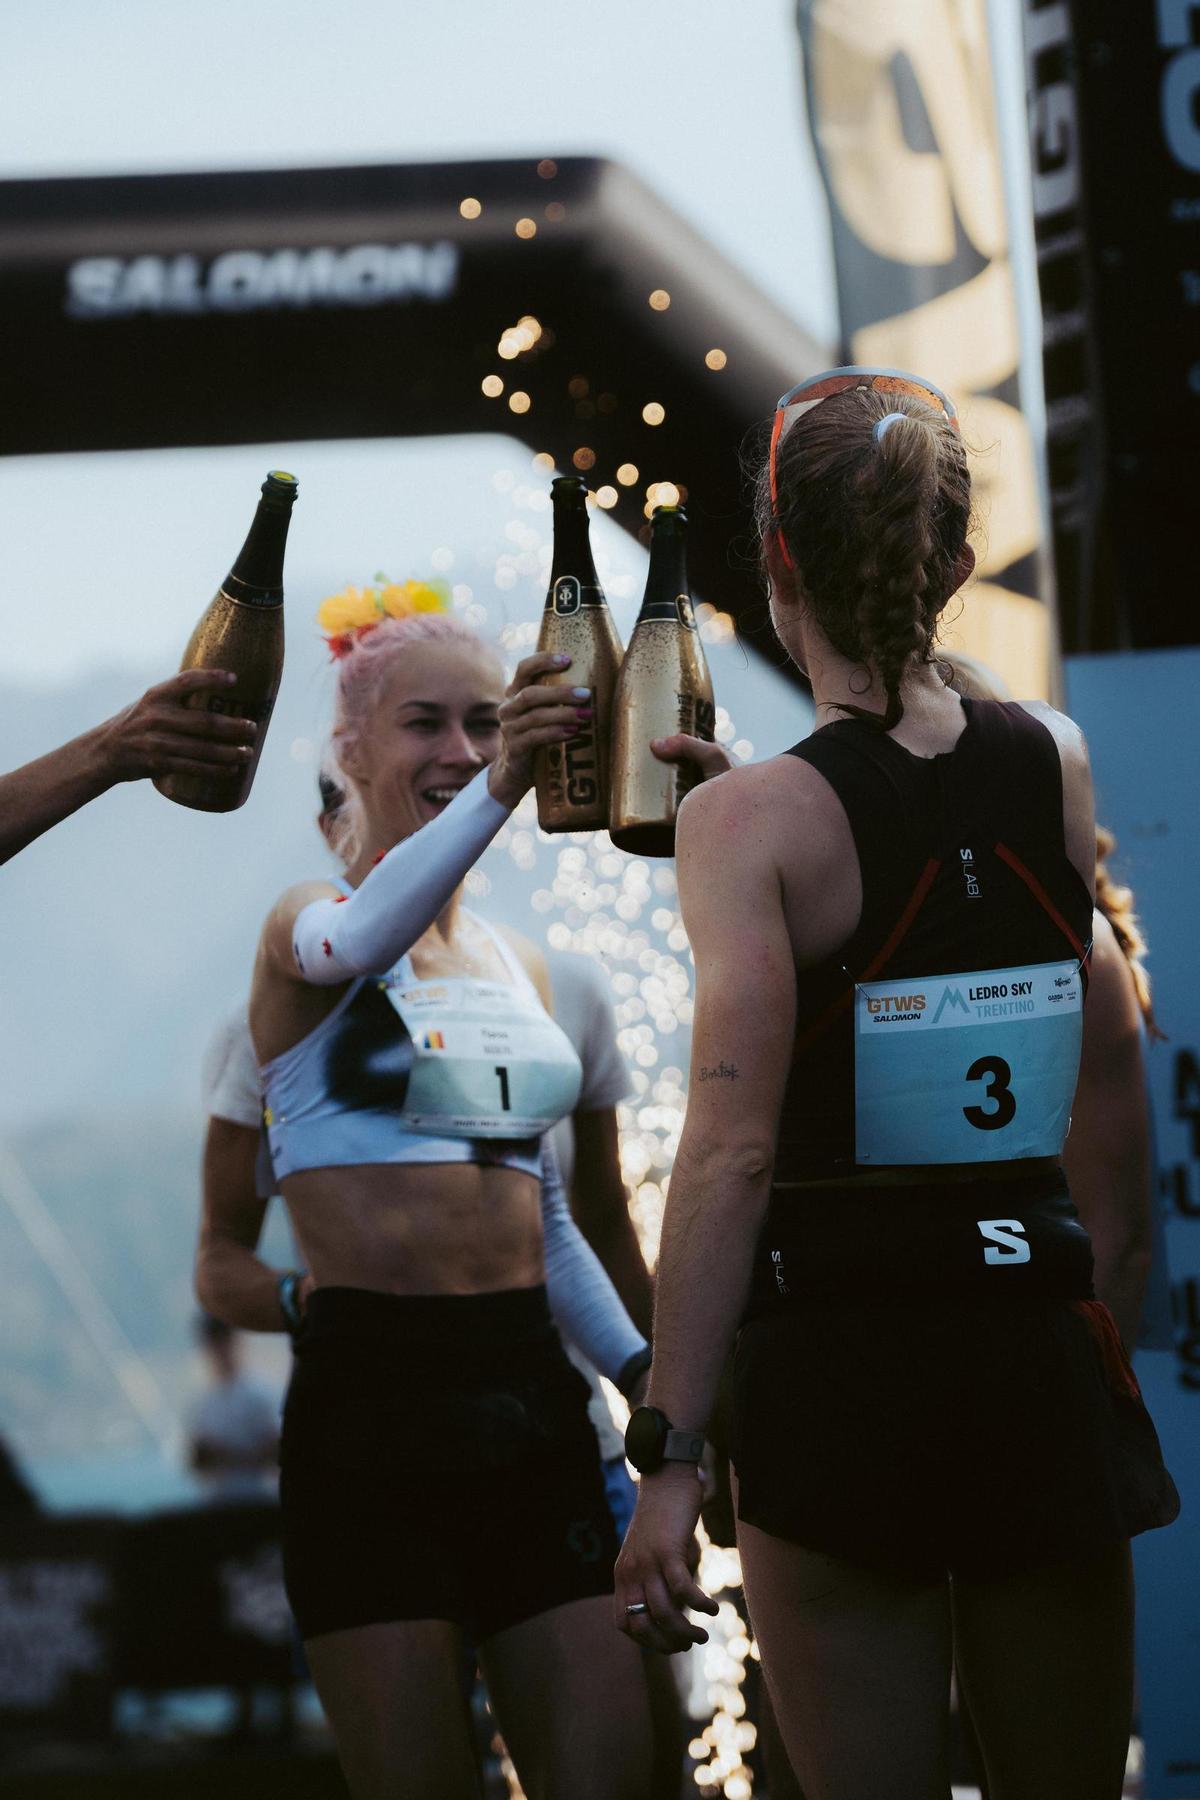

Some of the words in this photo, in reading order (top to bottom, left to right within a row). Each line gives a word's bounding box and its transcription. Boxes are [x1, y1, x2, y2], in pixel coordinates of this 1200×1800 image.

[66, 240, 460, 317] SALOMON
[969, 985, 1008, 1001] LEDRO
[1011, 981, 1033, 996] SKY
[867, 994, 927, 1014] GTWS
[976, 1000, 1035, 1018] TRENTINO
[873, 1012, 921, 1023] SALOMON
[495, 1066, 510, 1111] 1
[963, 1055, 1016, 1131] 3
